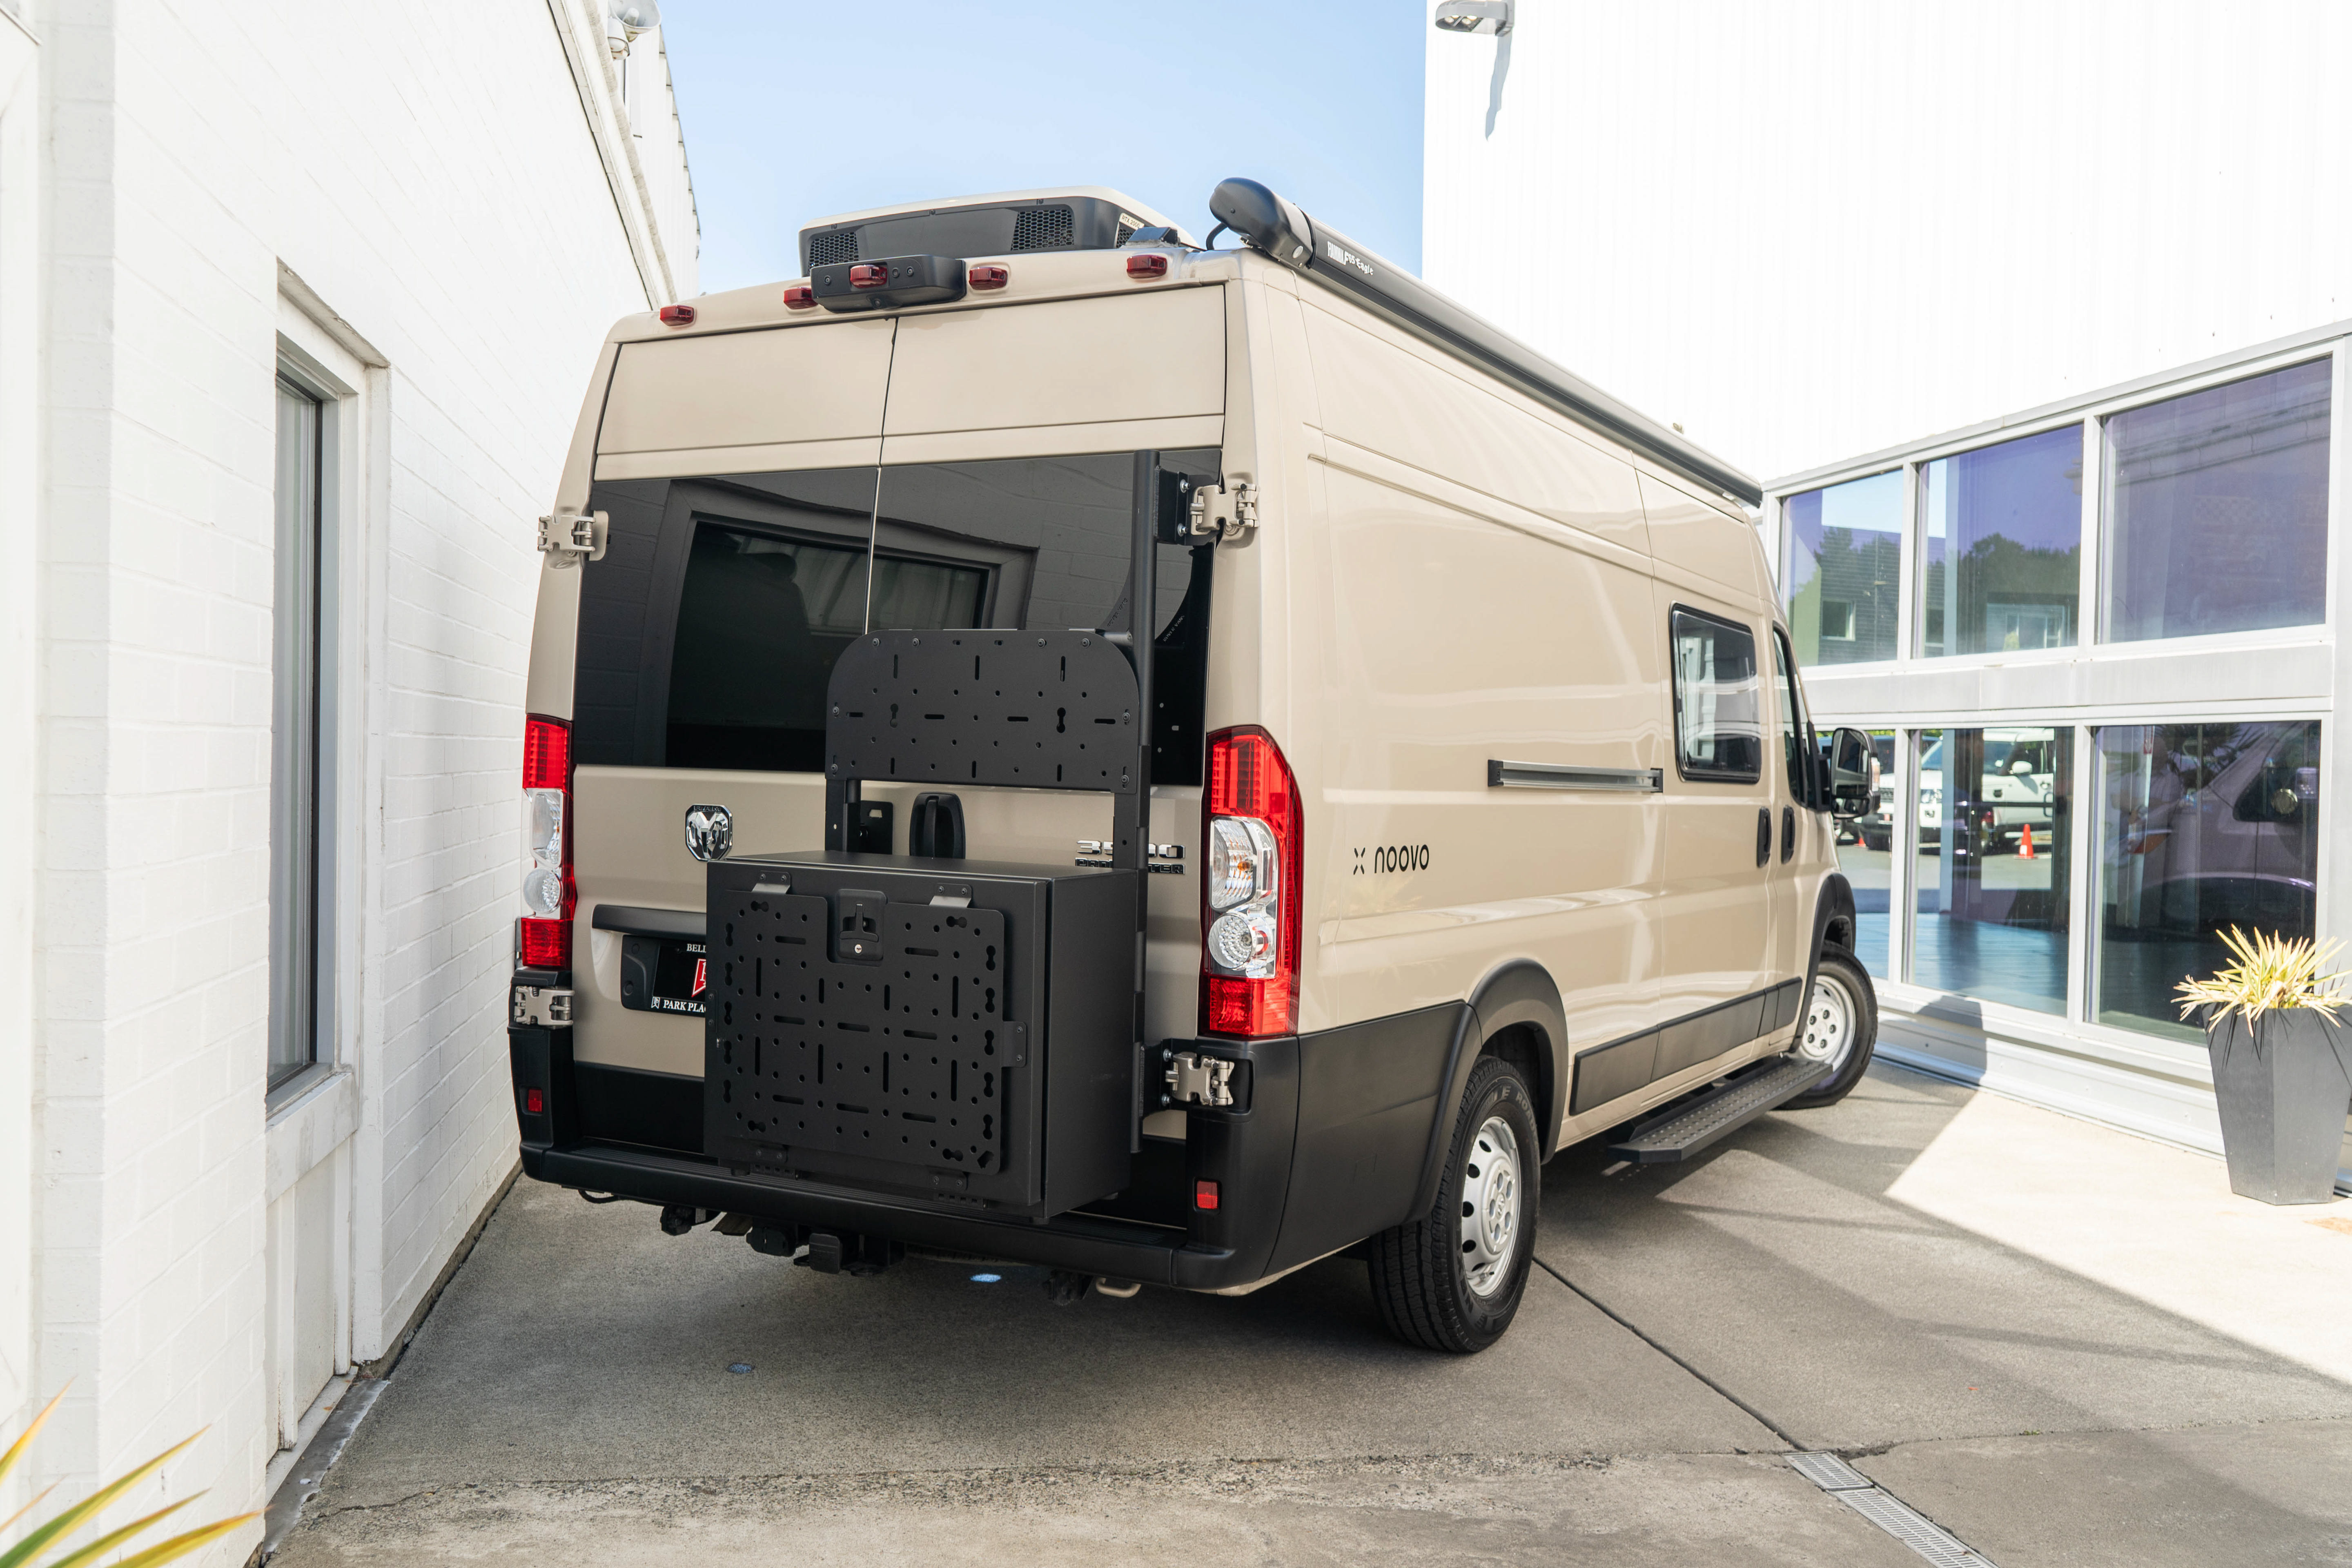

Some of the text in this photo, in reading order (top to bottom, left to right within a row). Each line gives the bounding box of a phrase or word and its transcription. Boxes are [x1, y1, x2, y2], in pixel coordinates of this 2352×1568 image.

[1121, 215, 1130, 223] RTX
[1355, 258, 1374, 276] Eagle
[1076, 840, 1186, 859] 30
[1075, 857, 1186, 875] PROTER
[1374, 844, 1430, 874] noovo
[663, 999, 687, 1011] PARK
[687, 1002, 706, 1013] PLA
